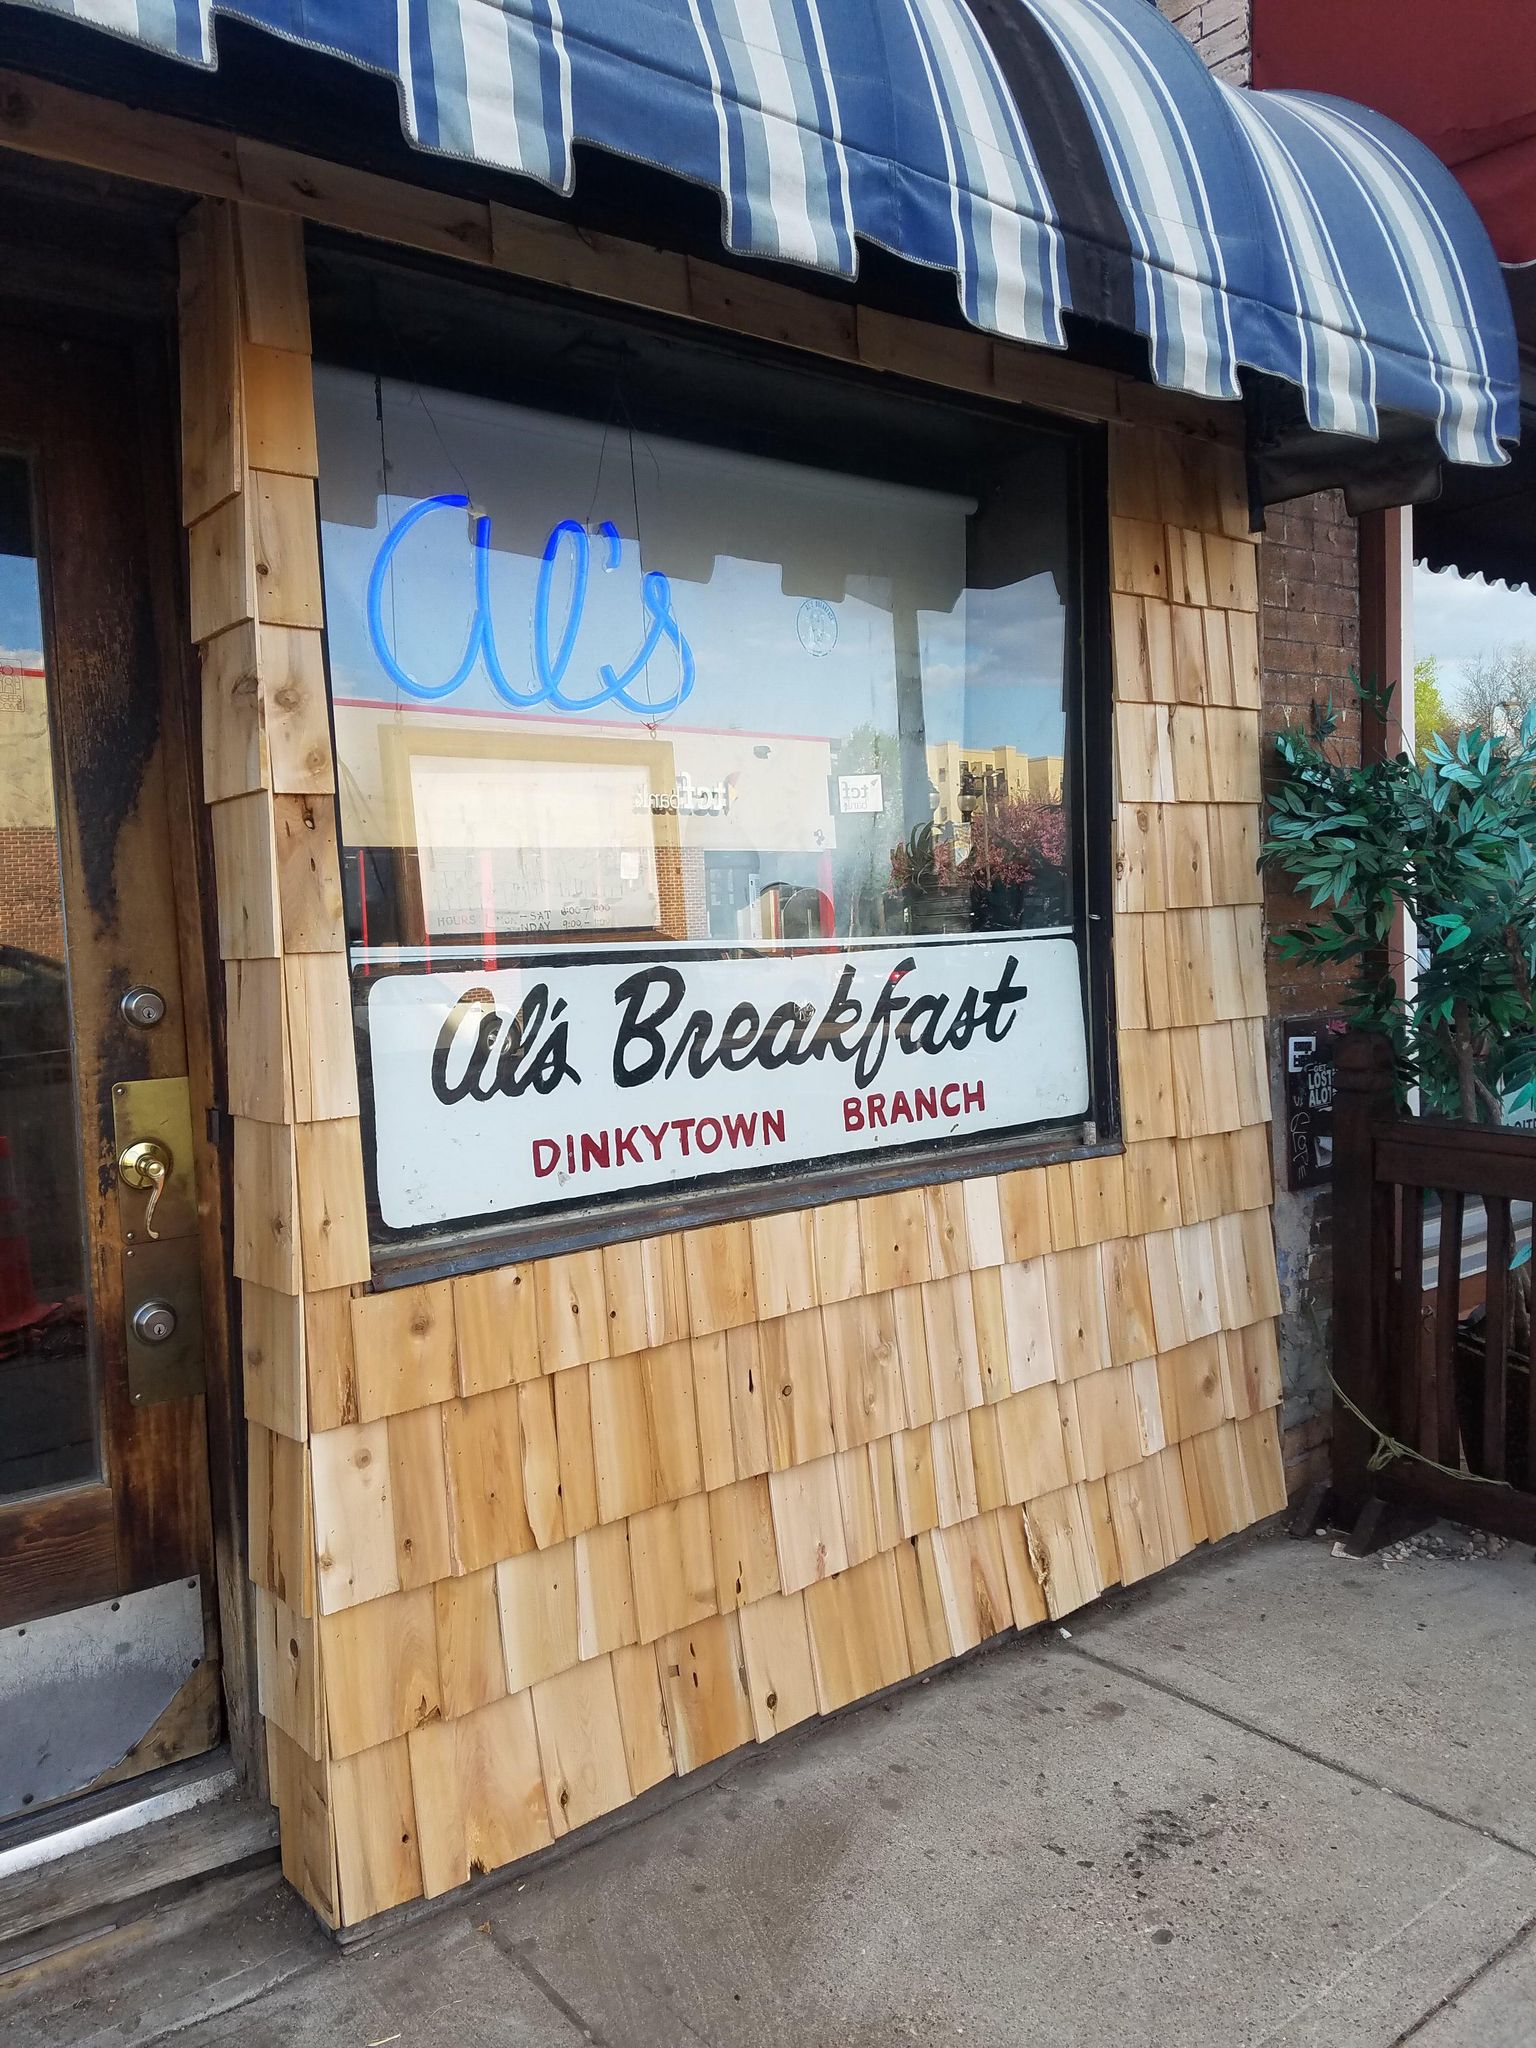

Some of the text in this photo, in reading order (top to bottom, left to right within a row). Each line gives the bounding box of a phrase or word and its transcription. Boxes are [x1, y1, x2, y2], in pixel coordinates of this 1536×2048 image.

[437, 914, 476, 927] HOURS
[529, 909, 552, 920] SAT
[432, 955, 1028, 1105] Al's Breakfast
[1308, 1069, 1332, 1090] LOST
[532, 1080, 986, 1178] DINKYTOWN BRANCH
